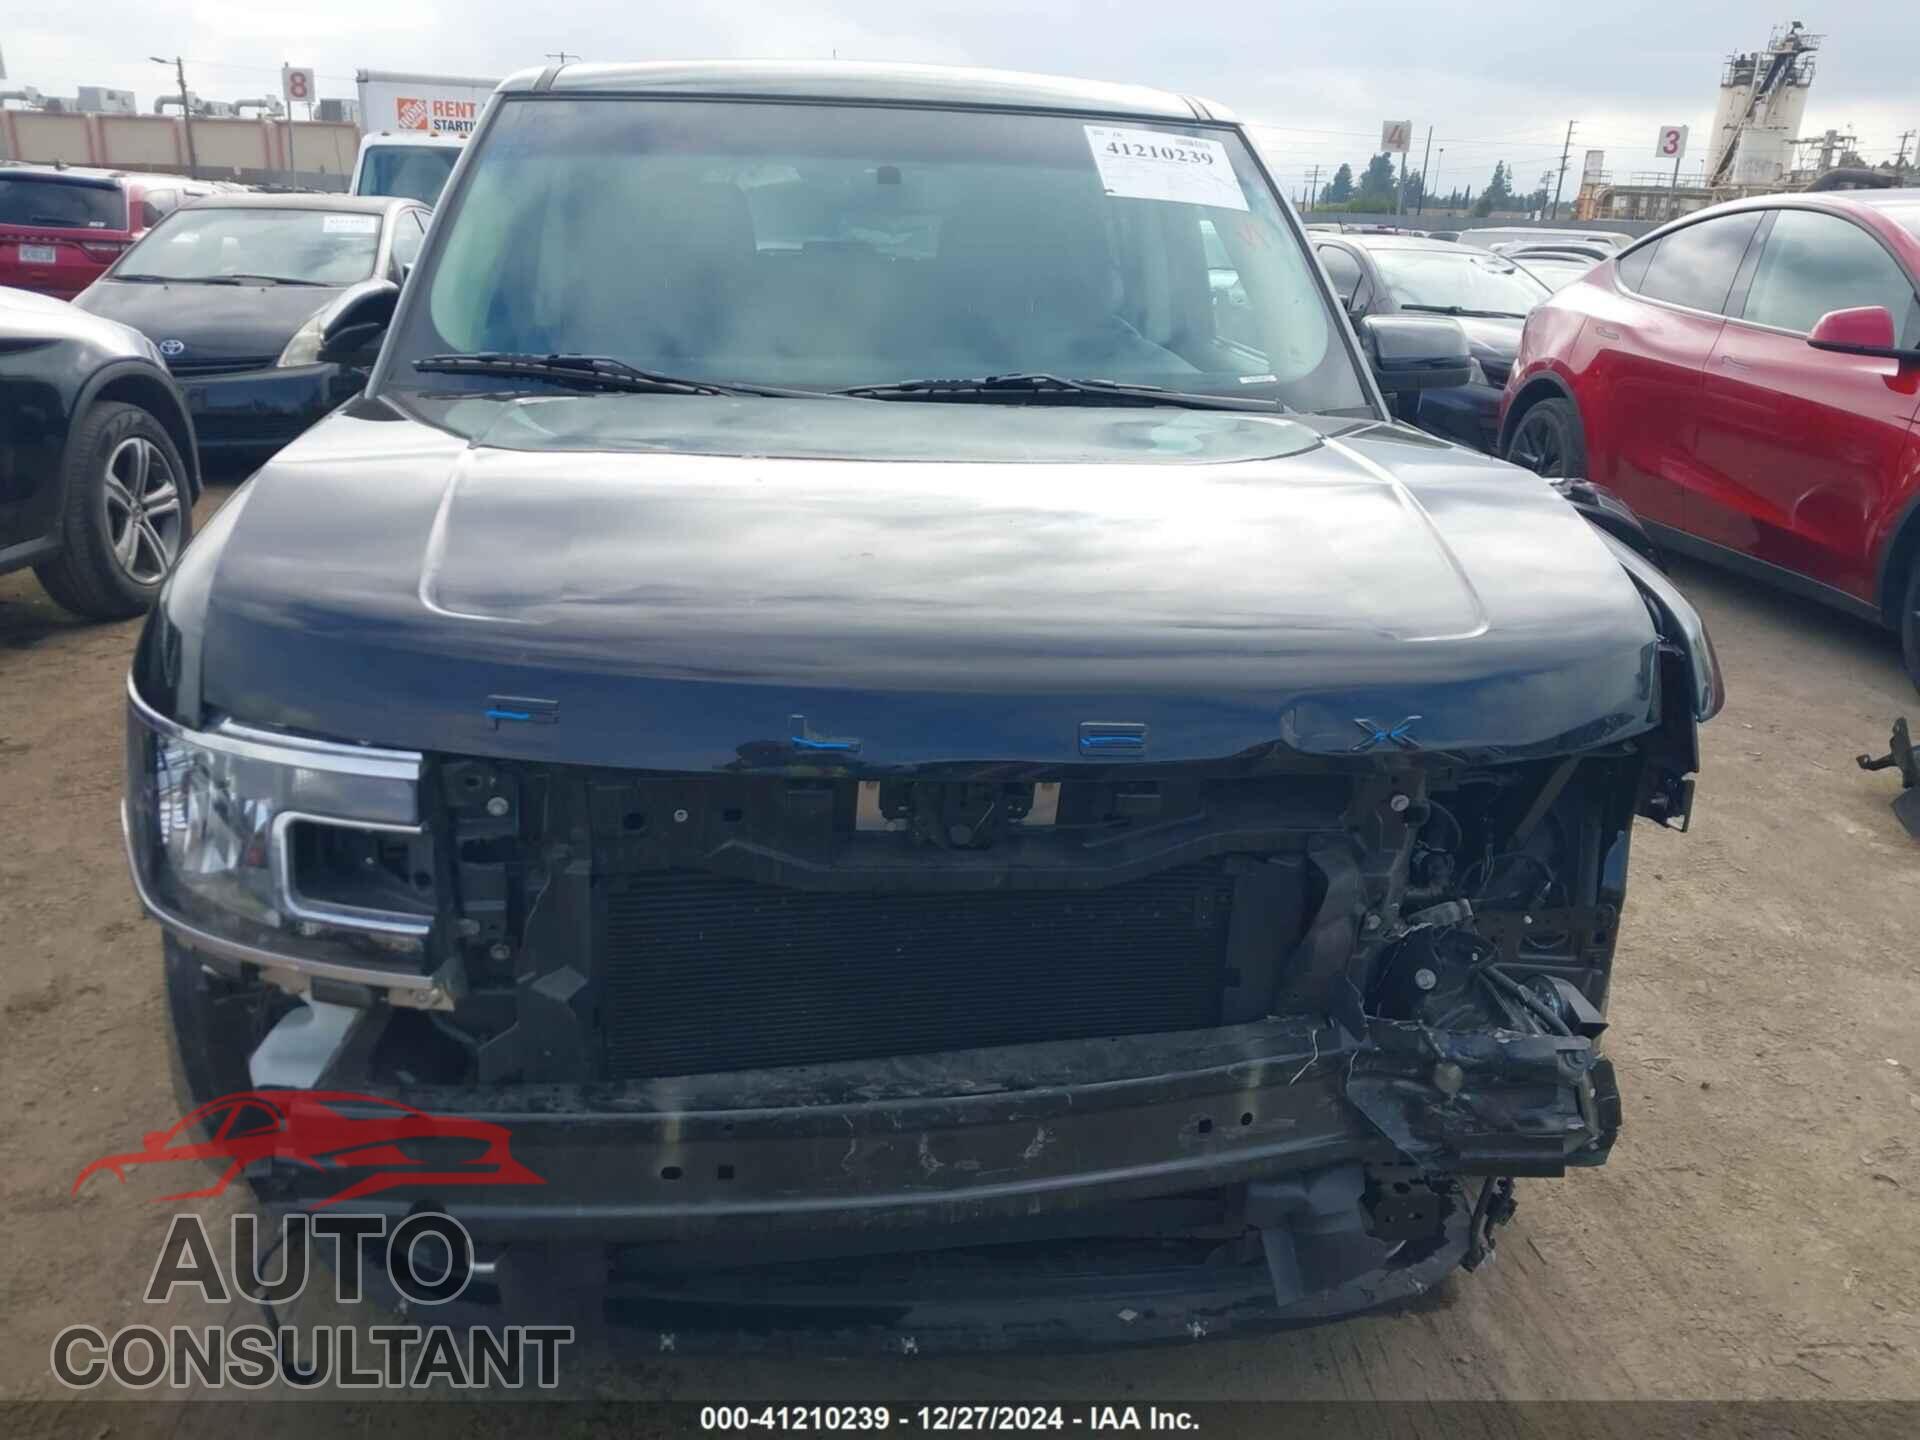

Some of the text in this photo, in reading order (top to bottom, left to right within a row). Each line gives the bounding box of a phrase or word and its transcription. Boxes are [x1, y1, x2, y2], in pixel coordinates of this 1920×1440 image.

[290, 72, 307, 98] 8
[433, 100, 477, 118] RENT
[1386, 124, 1405, 149] 4
[1663, 130, 1680, 155] 3
[1106, 141, 1214, 166] 41210239
